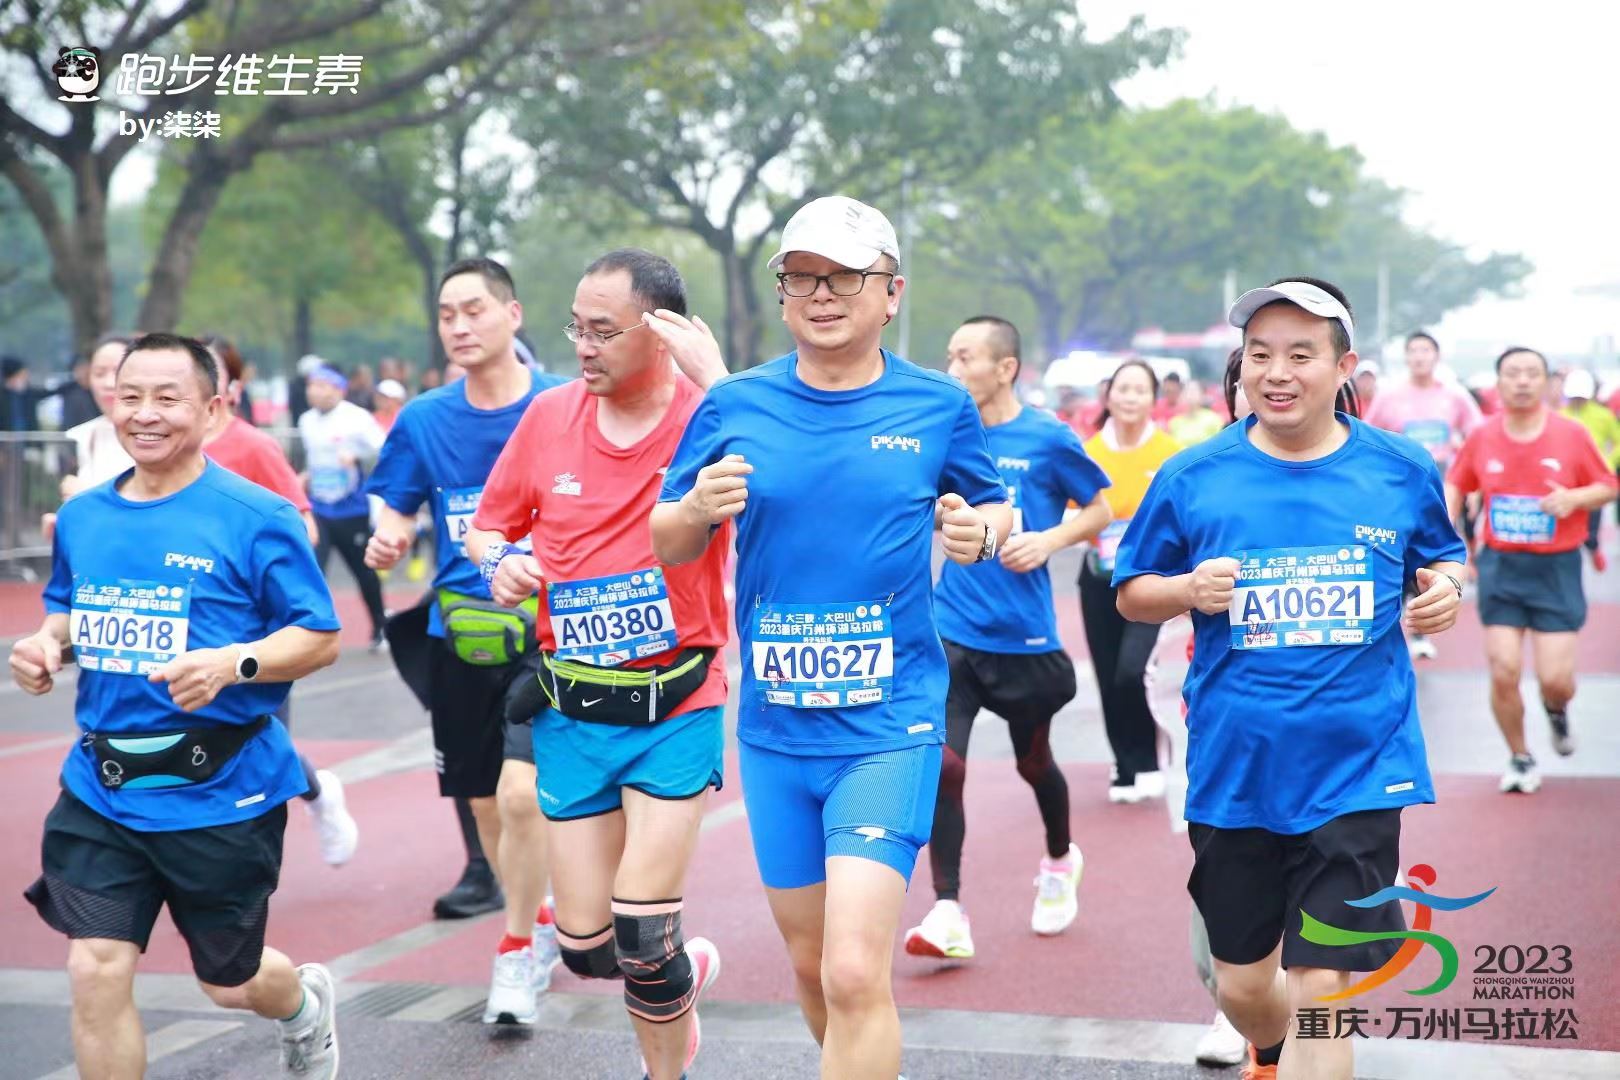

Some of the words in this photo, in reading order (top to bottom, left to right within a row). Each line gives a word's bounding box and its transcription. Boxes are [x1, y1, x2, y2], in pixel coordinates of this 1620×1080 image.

[1242, 584, 1361, 622] A10621
[78, 614, 174, 651] A10618
[562, 605, 663, 646] A10380
[759, 619, 884, 635] 2023重庆万州环湖马拉松
[763, 642, 882, 680] A10627
